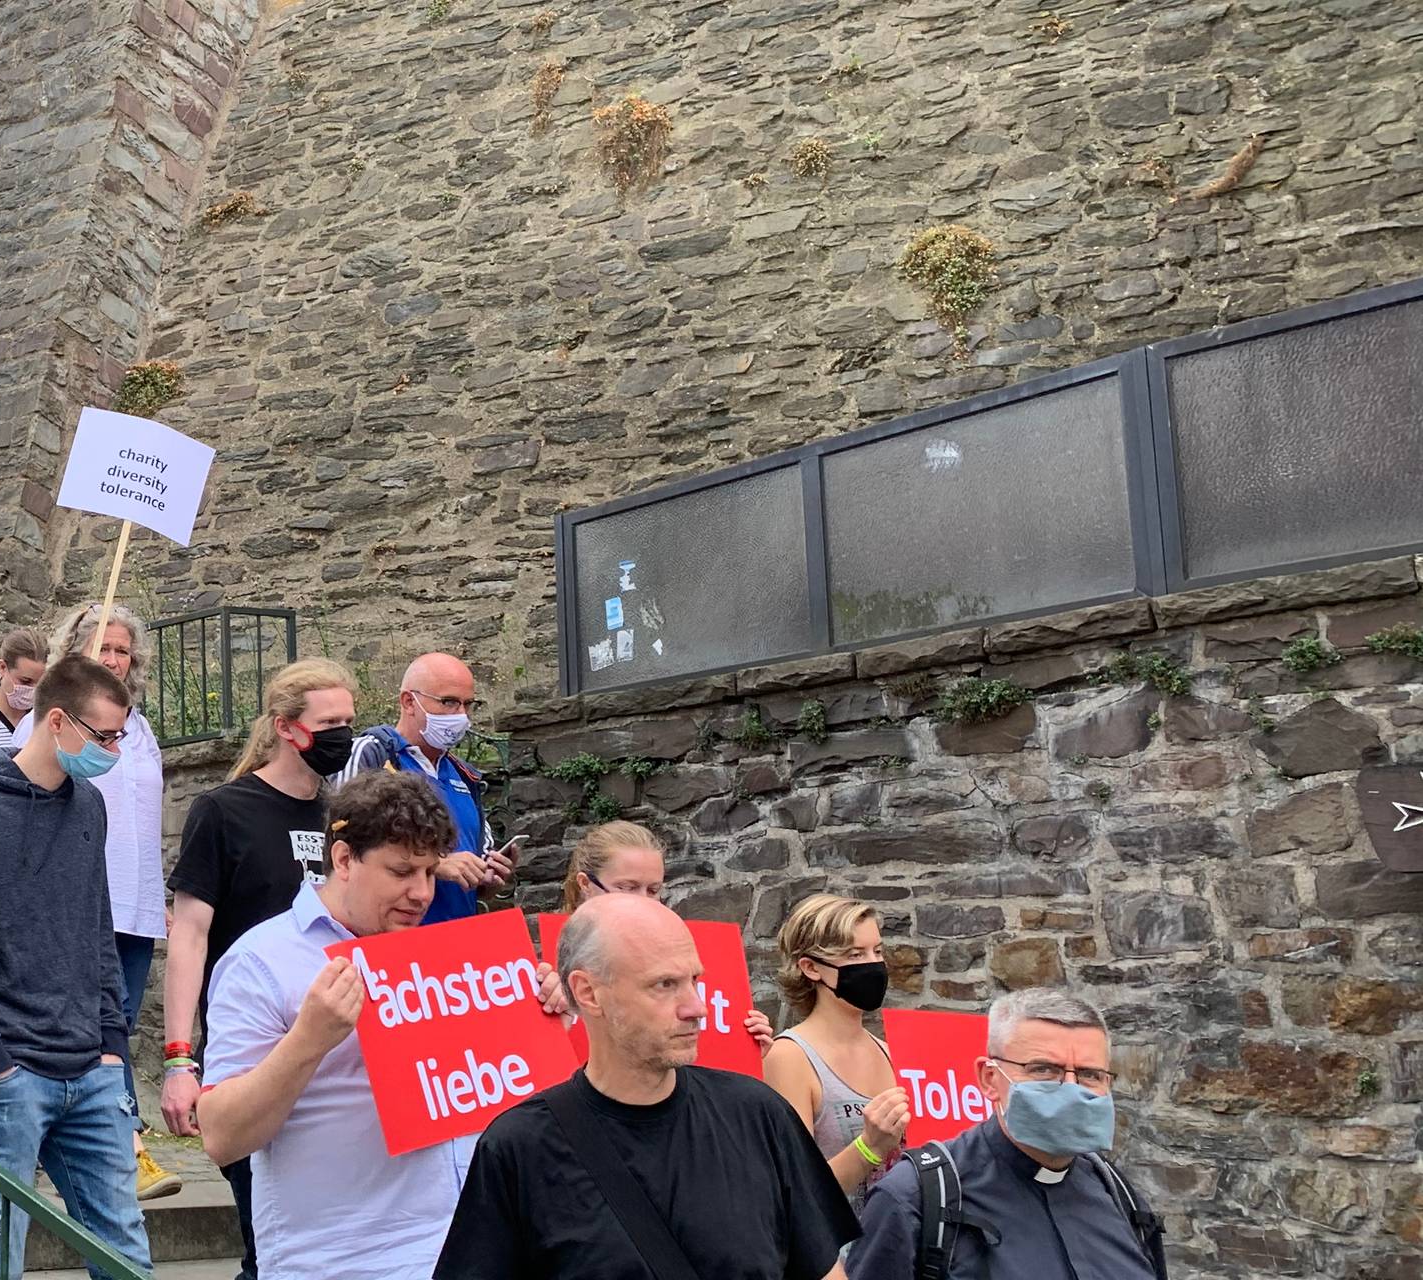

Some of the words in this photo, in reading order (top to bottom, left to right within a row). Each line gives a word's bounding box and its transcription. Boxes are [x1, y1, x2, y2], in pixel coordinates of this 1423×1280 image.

[119, 448, 168, 473] charity
[107, 465, 168, 495] diversity
[100, 481, 165, 511] tolerance
[416, 1049, 534, 1120] liebe
